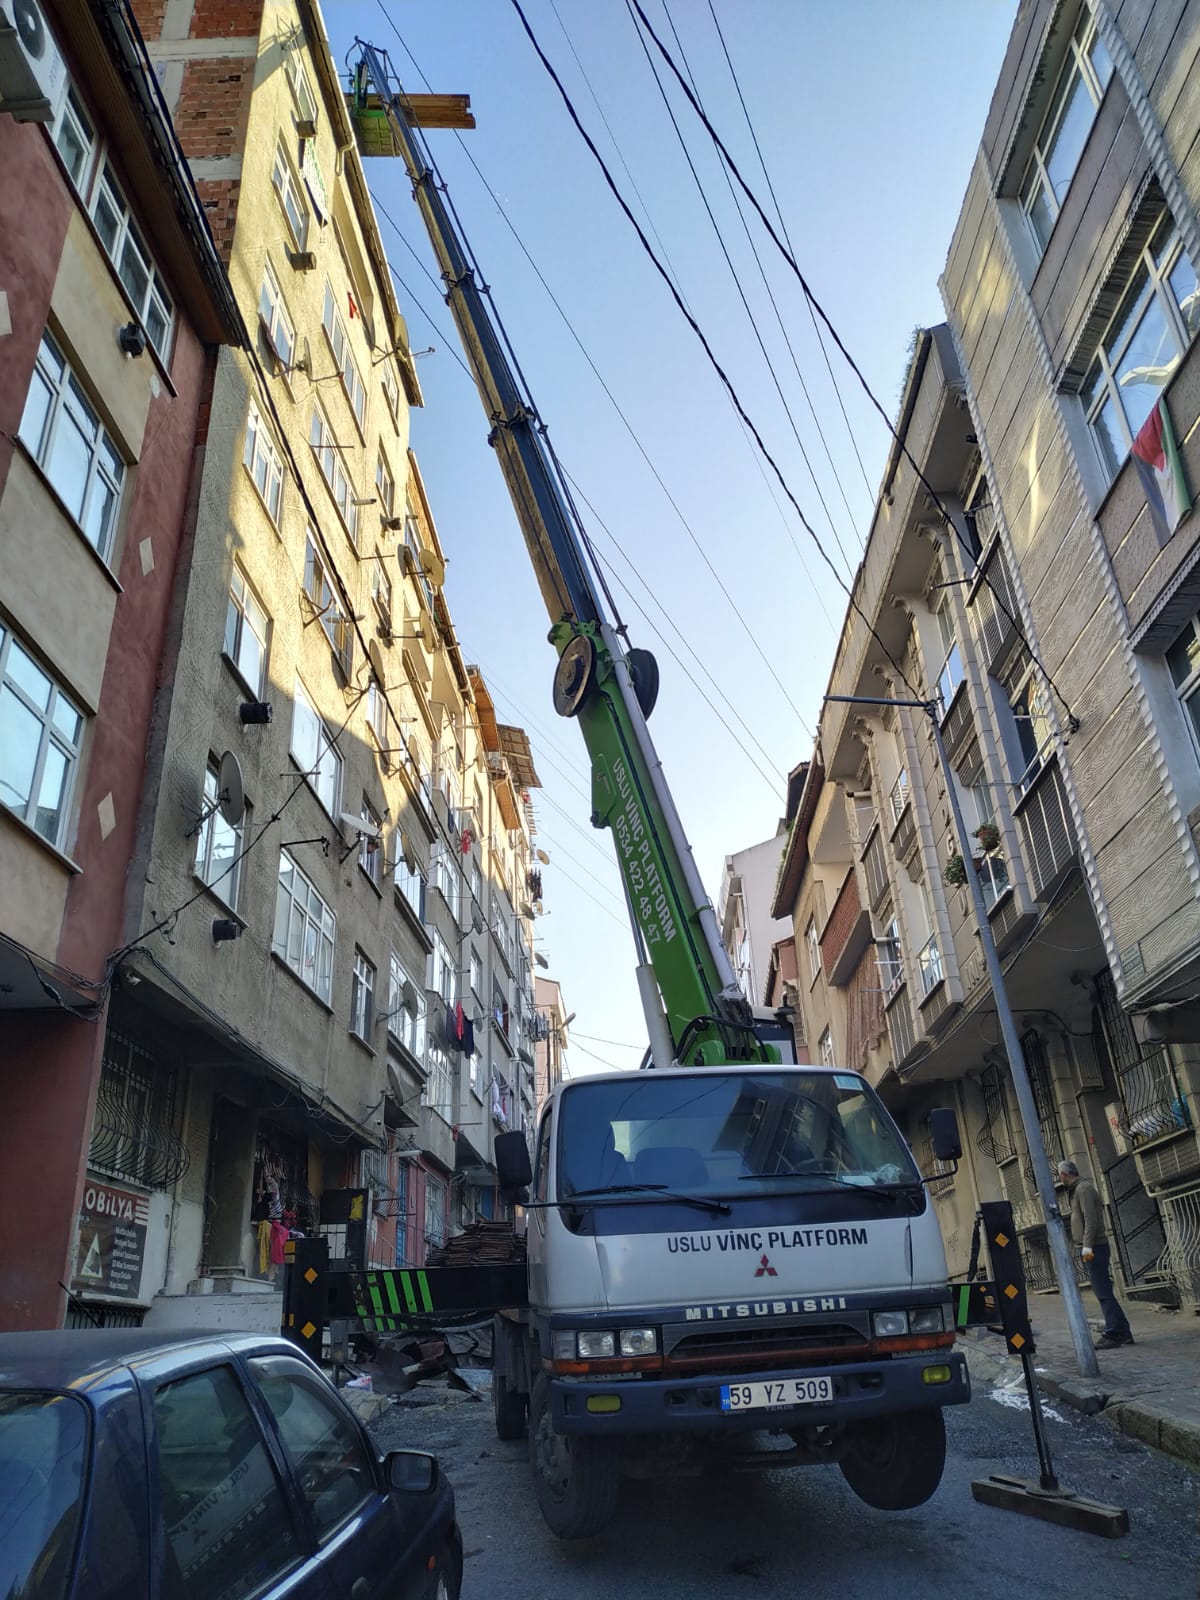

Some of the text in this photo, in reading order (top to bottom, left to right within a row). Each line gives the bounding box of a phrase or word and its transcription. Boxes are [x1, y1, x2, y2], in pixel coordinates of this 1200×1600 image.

[613, 758, 631, 799] USLU
[638, 840, 677, 943] PLATFORM
[616, 815, 660, 944] 0534 422 48 47
[667, 1228, 868, 1253] USLU VİNÇ PLATFORM
[685, 1297, 847, 1321] MITSUBISHI
[730, 1379, 828, 1406] 59 YZ 509
